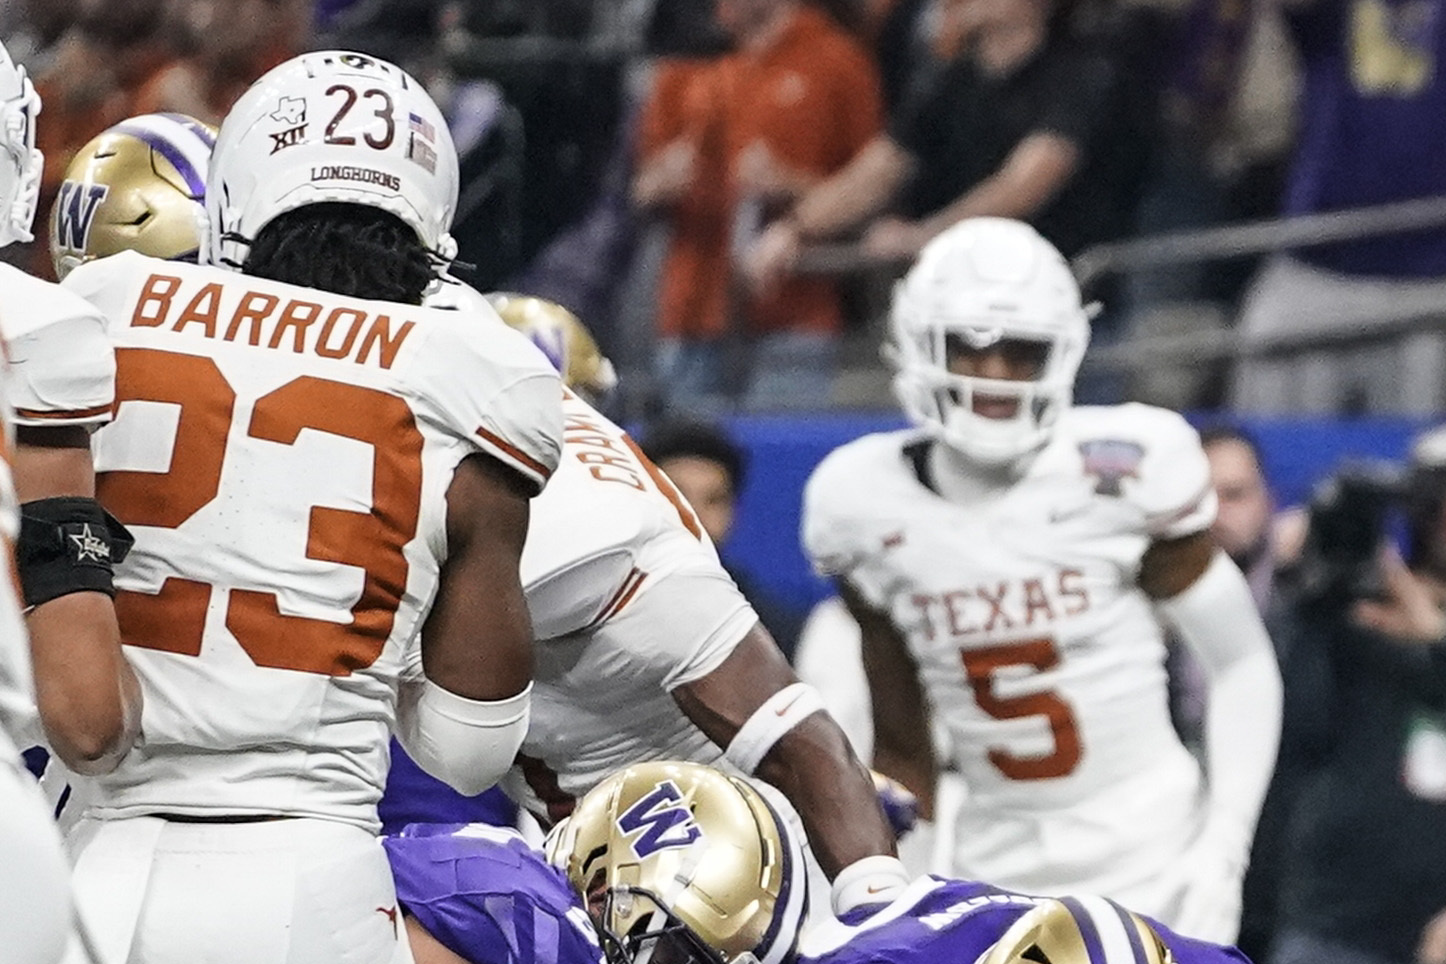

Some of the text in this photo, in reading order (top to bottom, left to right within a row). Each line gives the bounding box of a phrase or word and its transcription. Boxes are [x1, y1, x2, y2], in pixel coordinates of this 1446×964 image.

[324, 84, 396, 150] 23
[56, 180, 110, 252] W
[311, 166, 401, 192] LONGHORNS
[130, 273, 417, 370] BARRON
[94, 346, 426, 677] 23
[911, 566, 1091, 642] TEXAS
[961, 638, 1084, 782] 5
[615, 778, 703, 861] W
